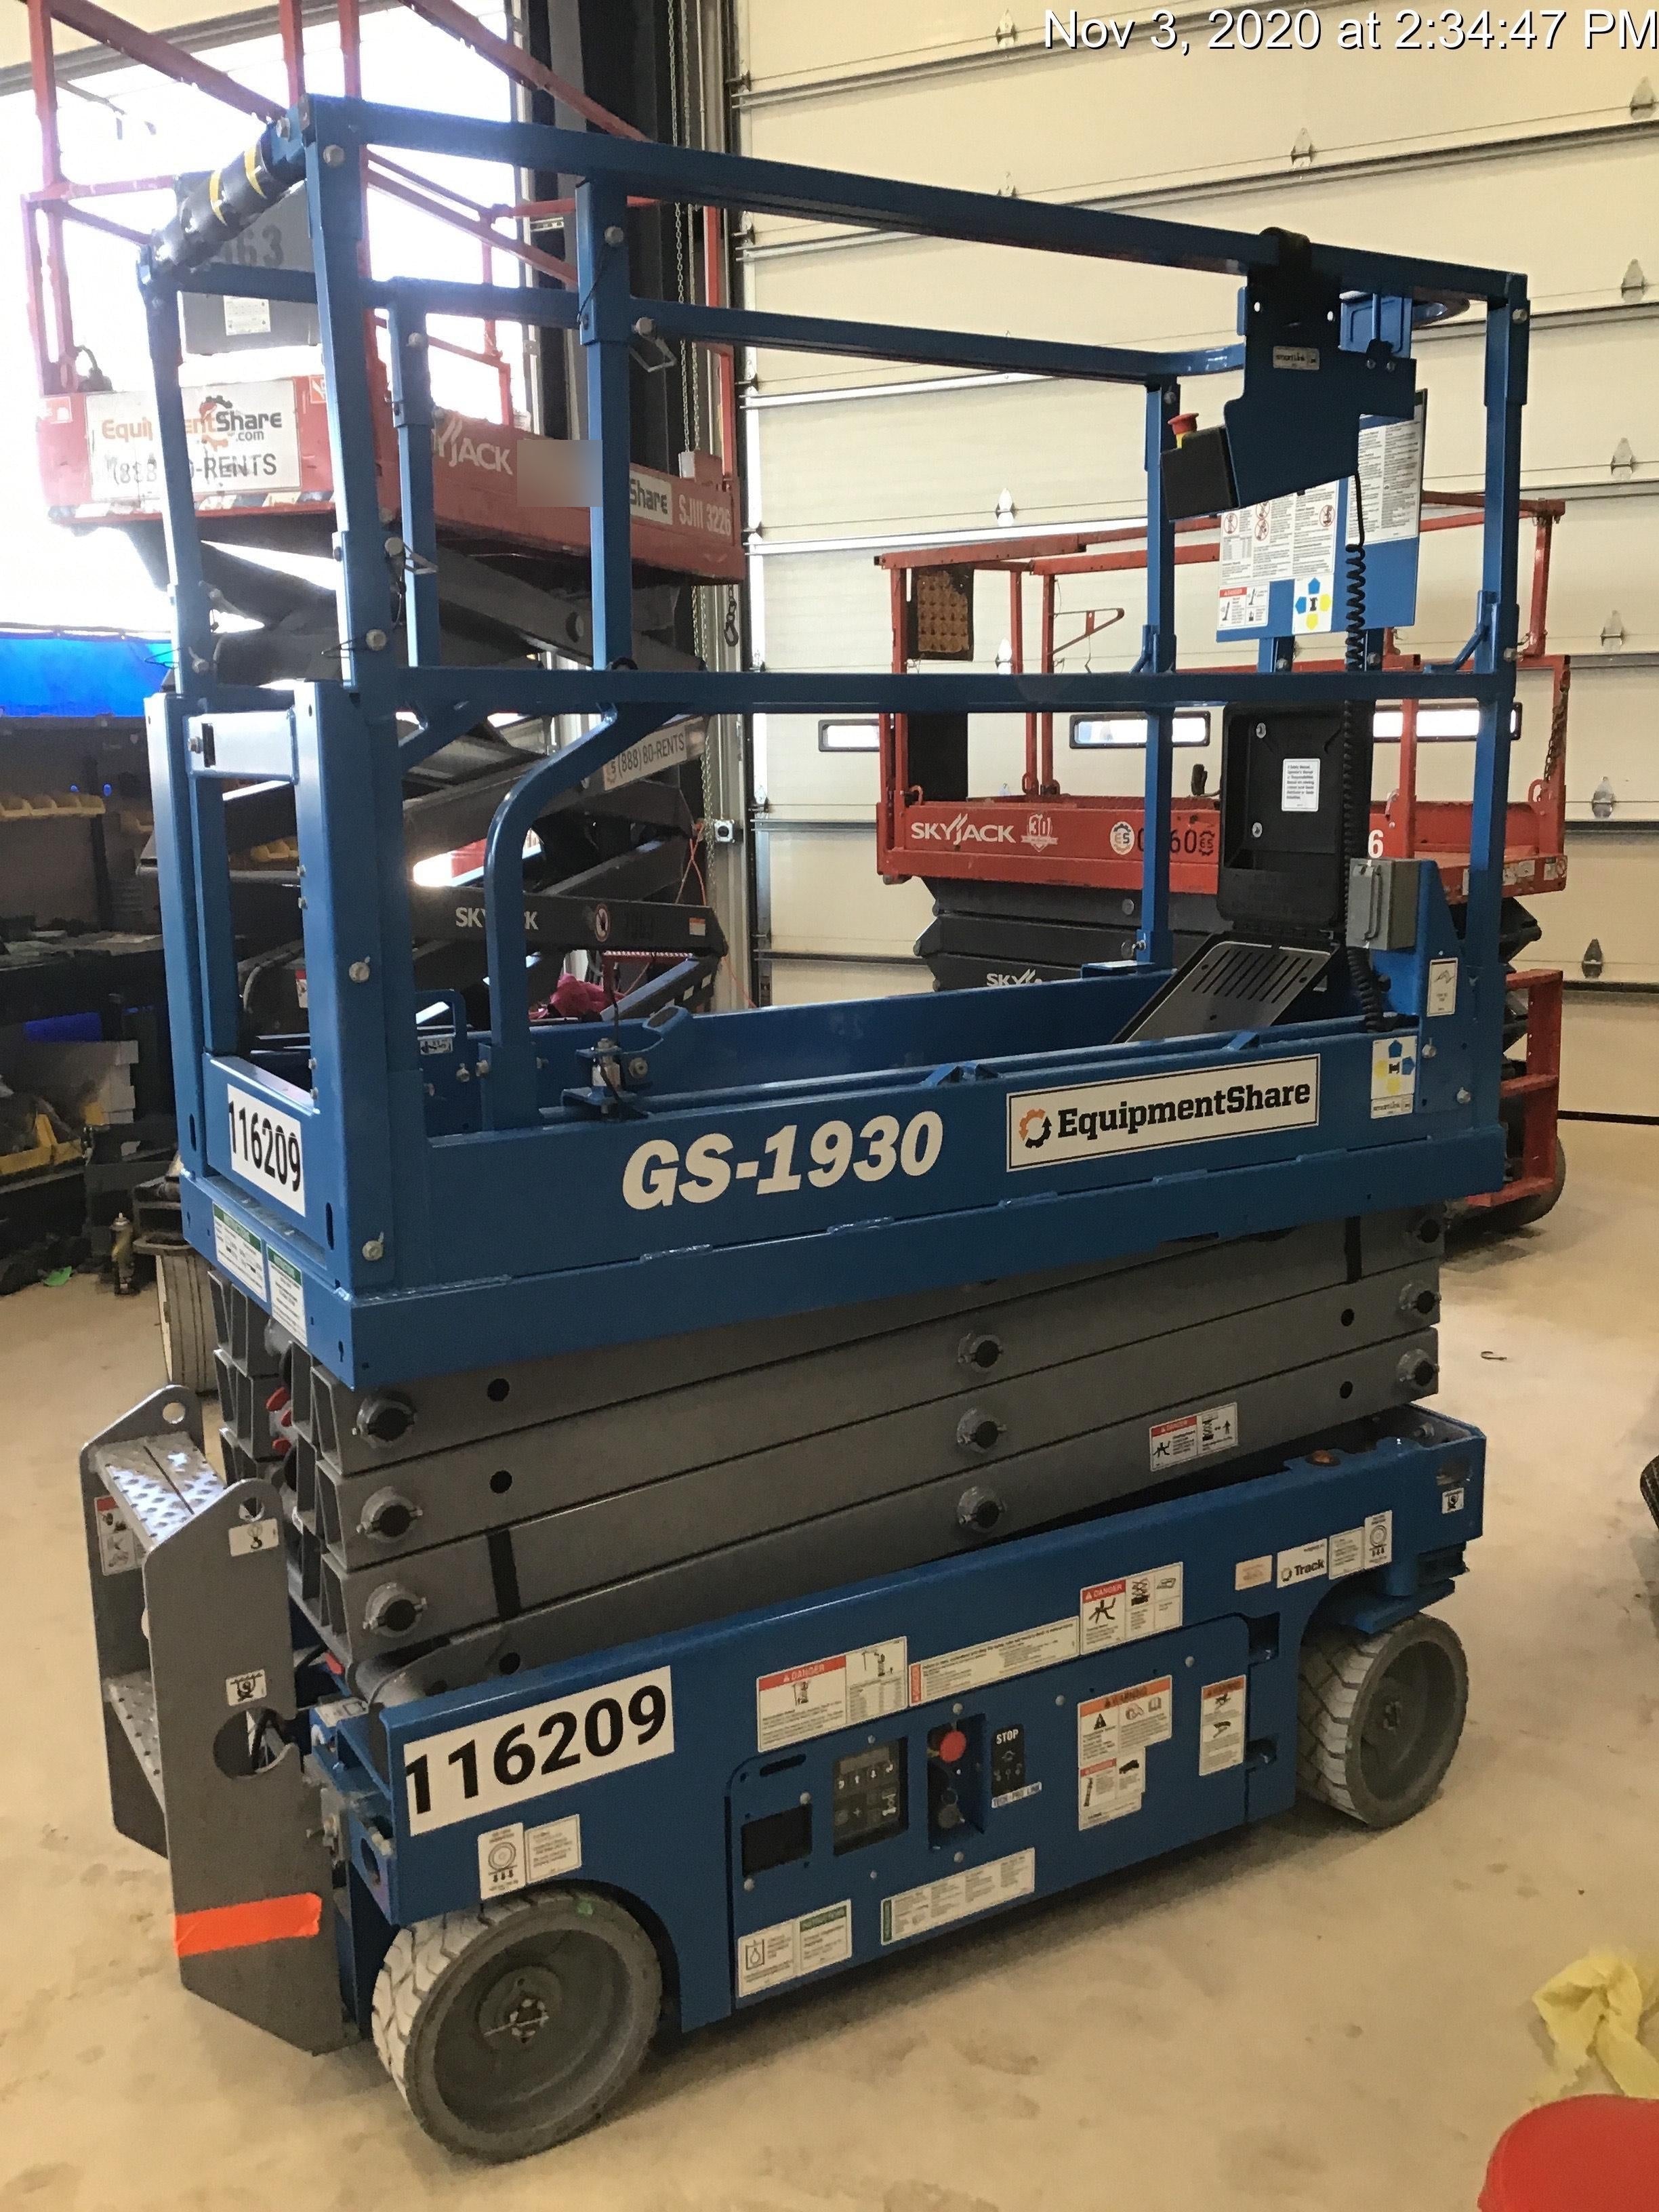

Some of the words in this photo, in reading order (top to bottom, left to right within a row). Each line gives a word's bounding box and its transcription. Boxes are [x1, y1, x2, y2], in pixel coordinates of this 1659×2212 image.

[911, 813, 1017, 846] SKYJACK
[1368, 829, 1384, 859] 6
[1057, 1083, 1311, 1141] EquipmentShare
[228, 1101, 301, 1192] 116209
[621, 1111, 944, 1211] GS-1930
[1294, 1559, 1325, 1576] Track
[406, 1685, 667, 1815] 116209
[996, 1729, 1019, 1744] STOP
